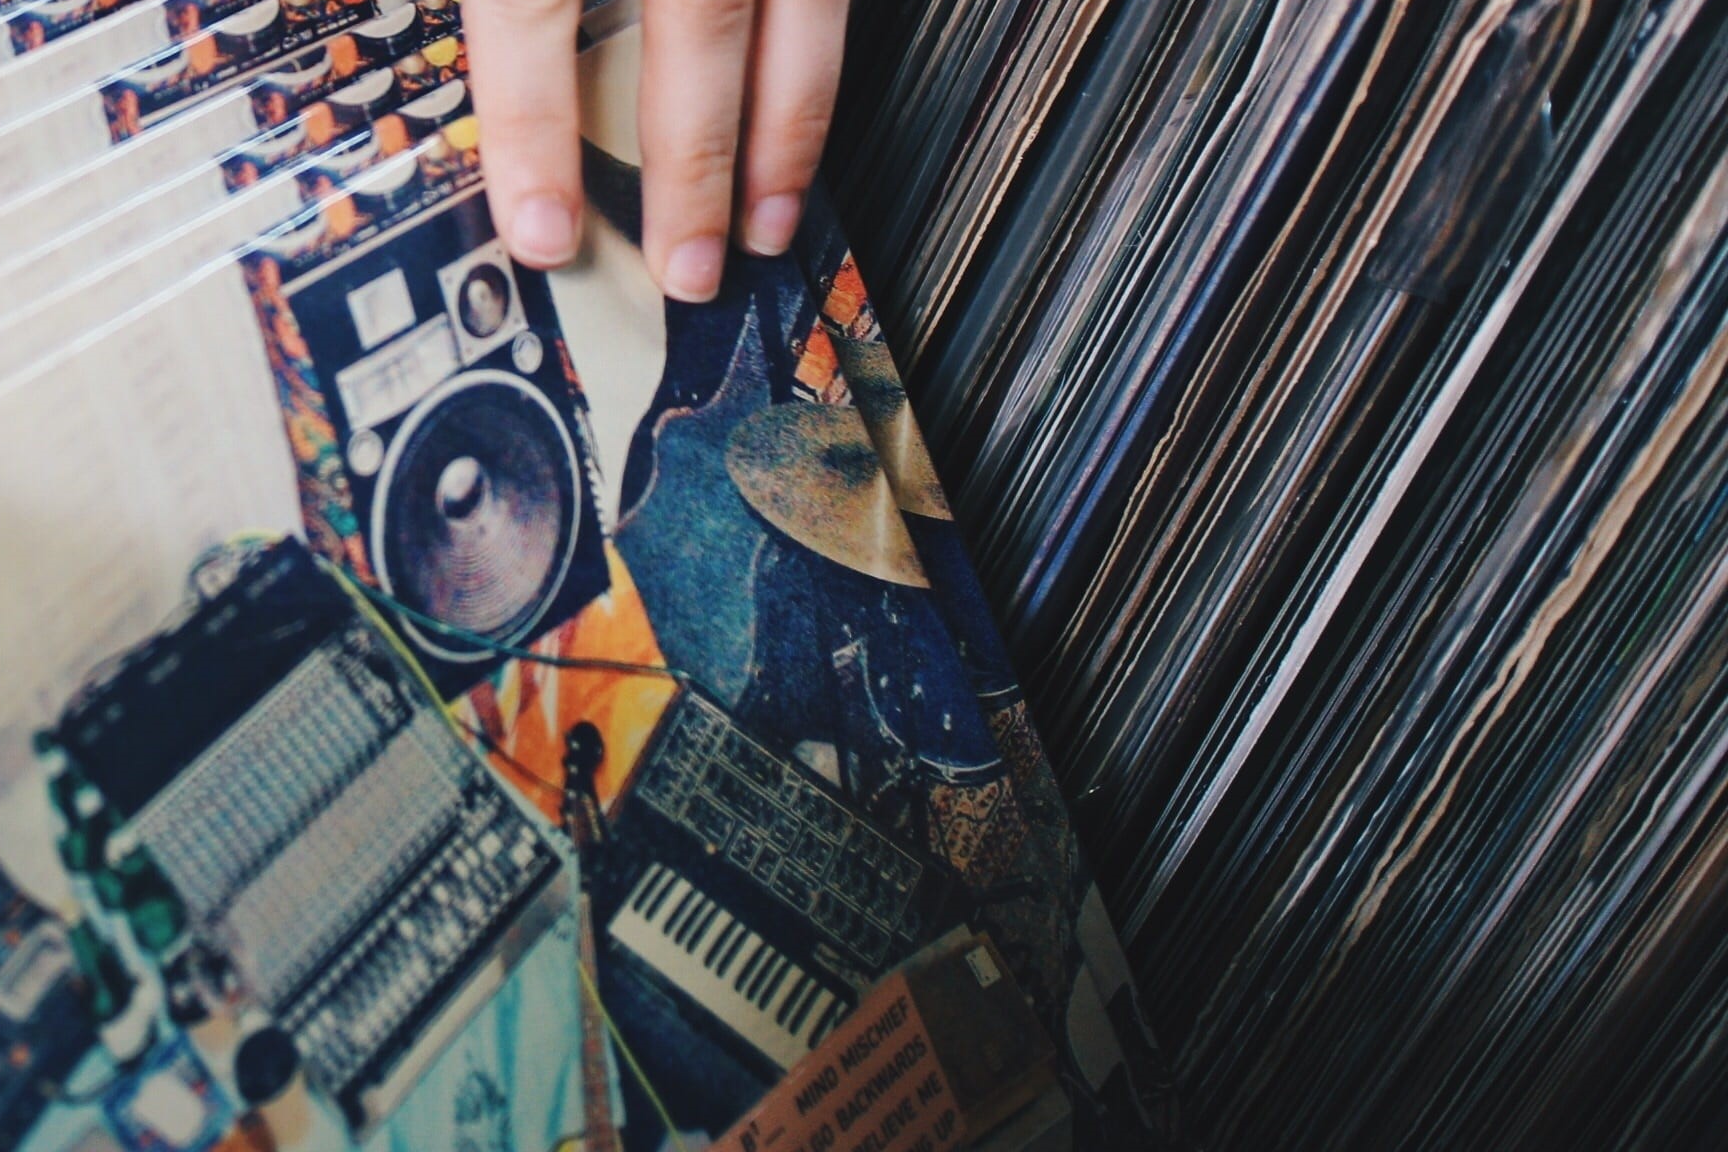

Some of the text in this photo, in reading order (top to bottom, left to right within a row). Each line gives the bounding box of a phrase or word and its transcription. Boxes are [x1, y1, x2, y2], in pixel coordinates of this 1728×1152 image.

[793, 1065, 840, 1117] MIND
[839, 994, 909, 1074] MISCHIEF
[835, 1033, 928, 1132] BACKWARDS
[915, 1071, 944, 1107] ME
[933, 1107, 956, 1142] UP
